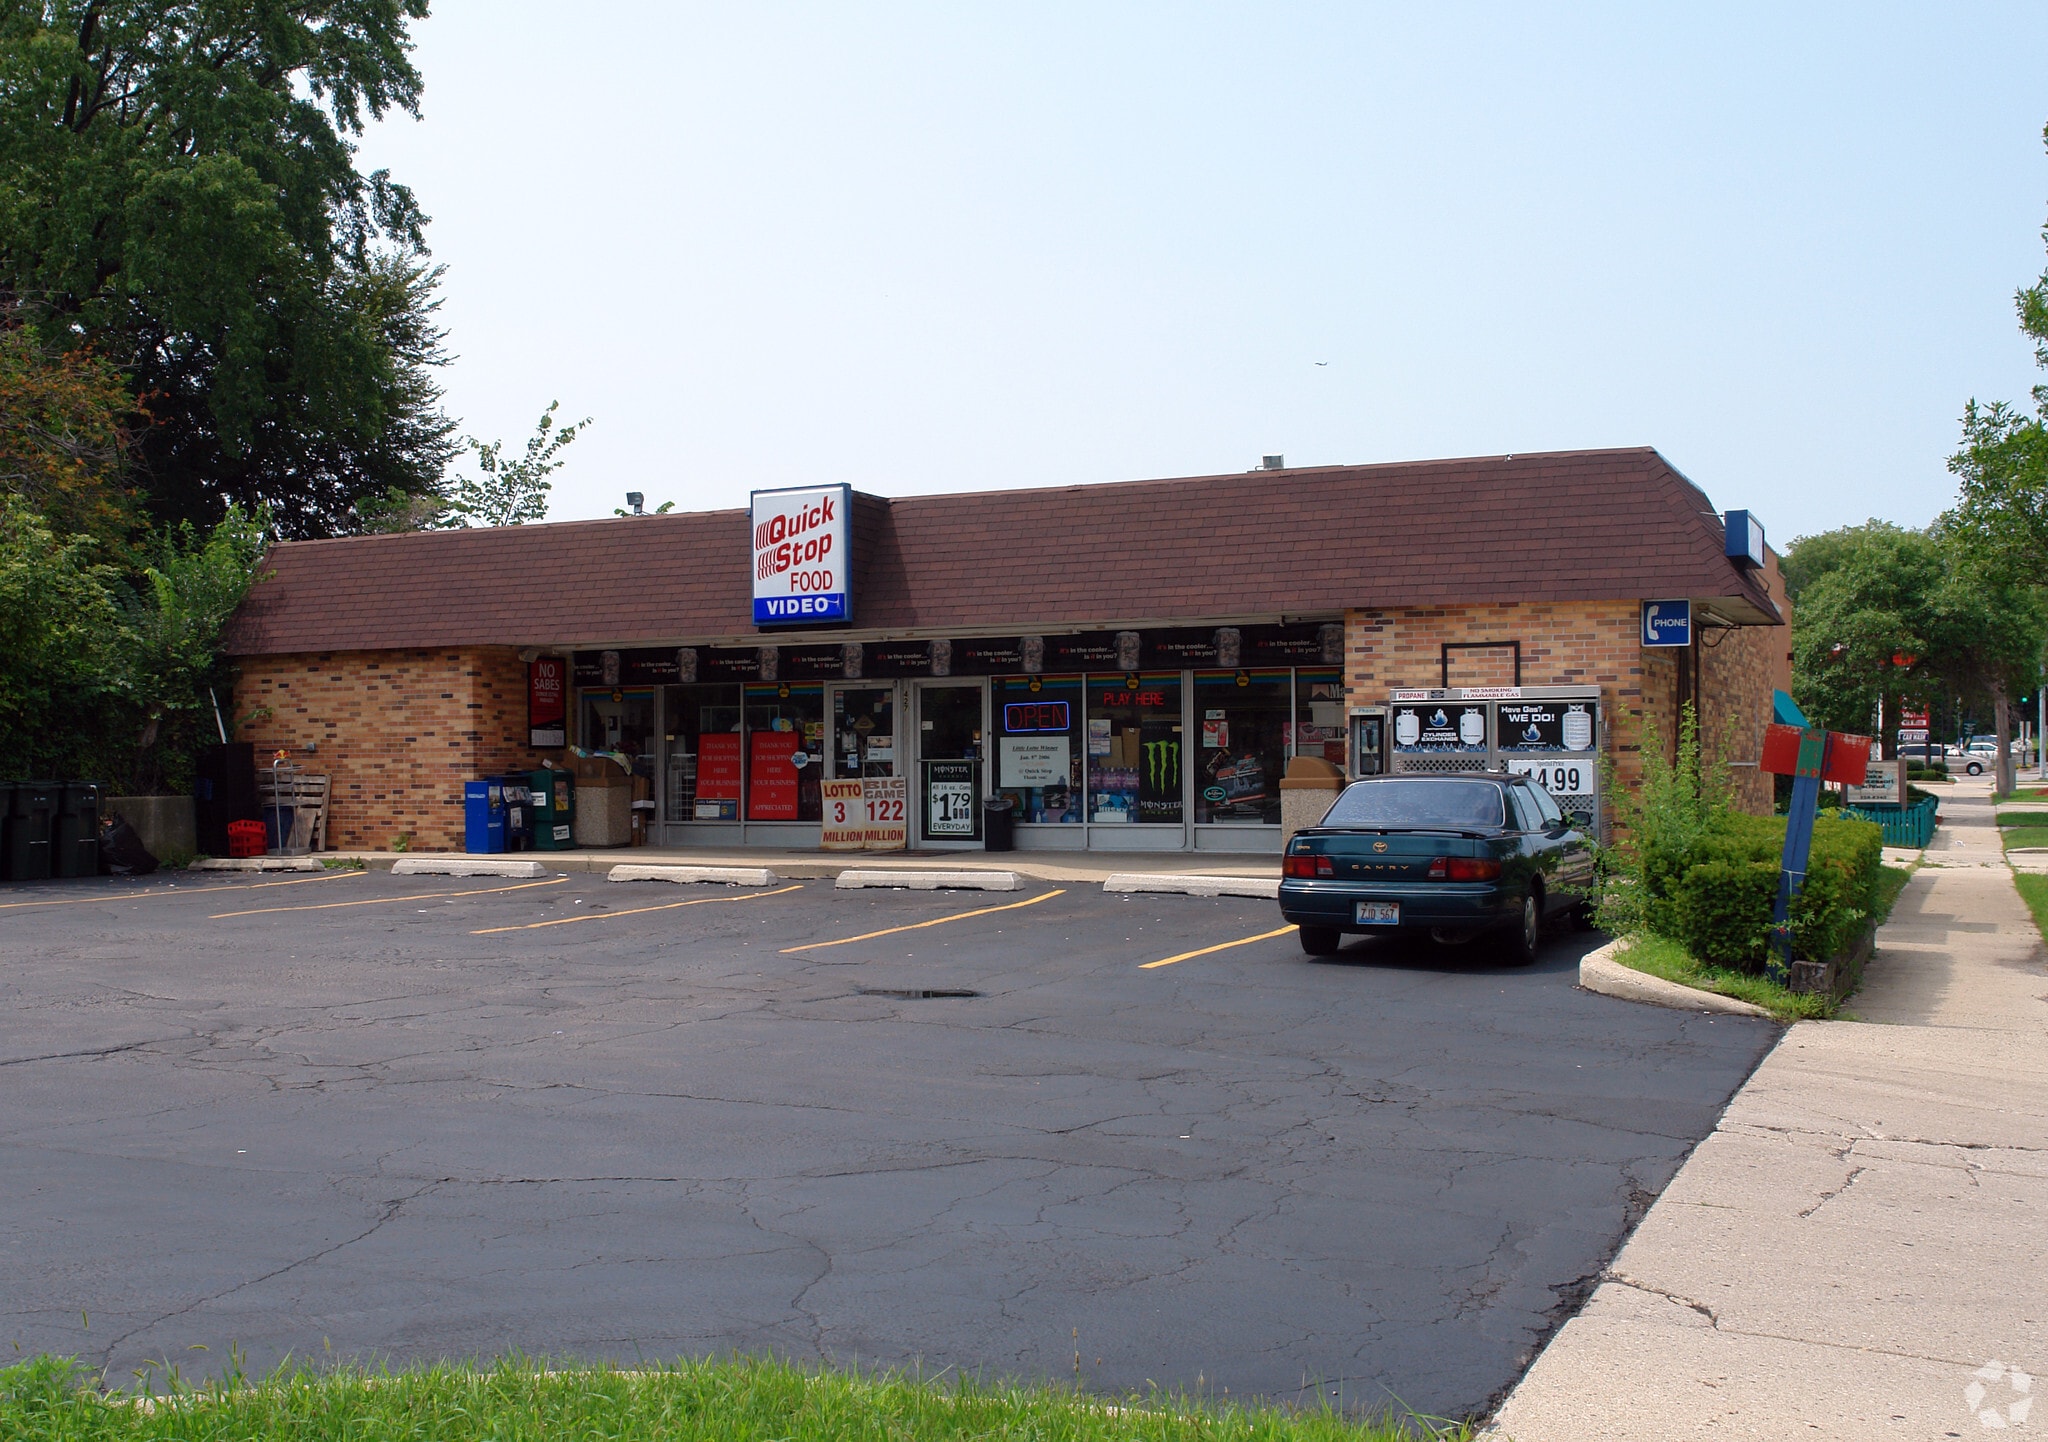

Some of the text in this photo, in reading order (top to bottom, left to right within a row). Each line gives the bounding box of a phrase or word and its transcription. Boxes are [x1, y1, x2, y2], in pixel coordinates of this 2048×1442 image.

[769, 496, 835, 544] Quick
[776, 533, 832, 573] Stop
[791, 570, 833, 592] FOOD
[767, 597, 828, 615] VIDEO
[1654, 618, 1687, 627] PHONE
[539, 664, 556, 678] NO
[534, 678, 560, 690] SABES
[1103, 692, 1165, 706] PLAY HERE
[1007, 705, 1066, 729] OPEN
[1508, 714, 1555, 722] WE DO!
[934, 766, 968, 774] MONSTER
[824, 784, 861, 798] LOTTO
[865, 780, 904, 789] BIG
[864, 790, 904, 799] GAME
[834, 802, 846, 823] 3
[867, 800, 904, 821] 122
[823, 831, 863, 842] MILLION
[865, 830, 904, 841] MILLION
